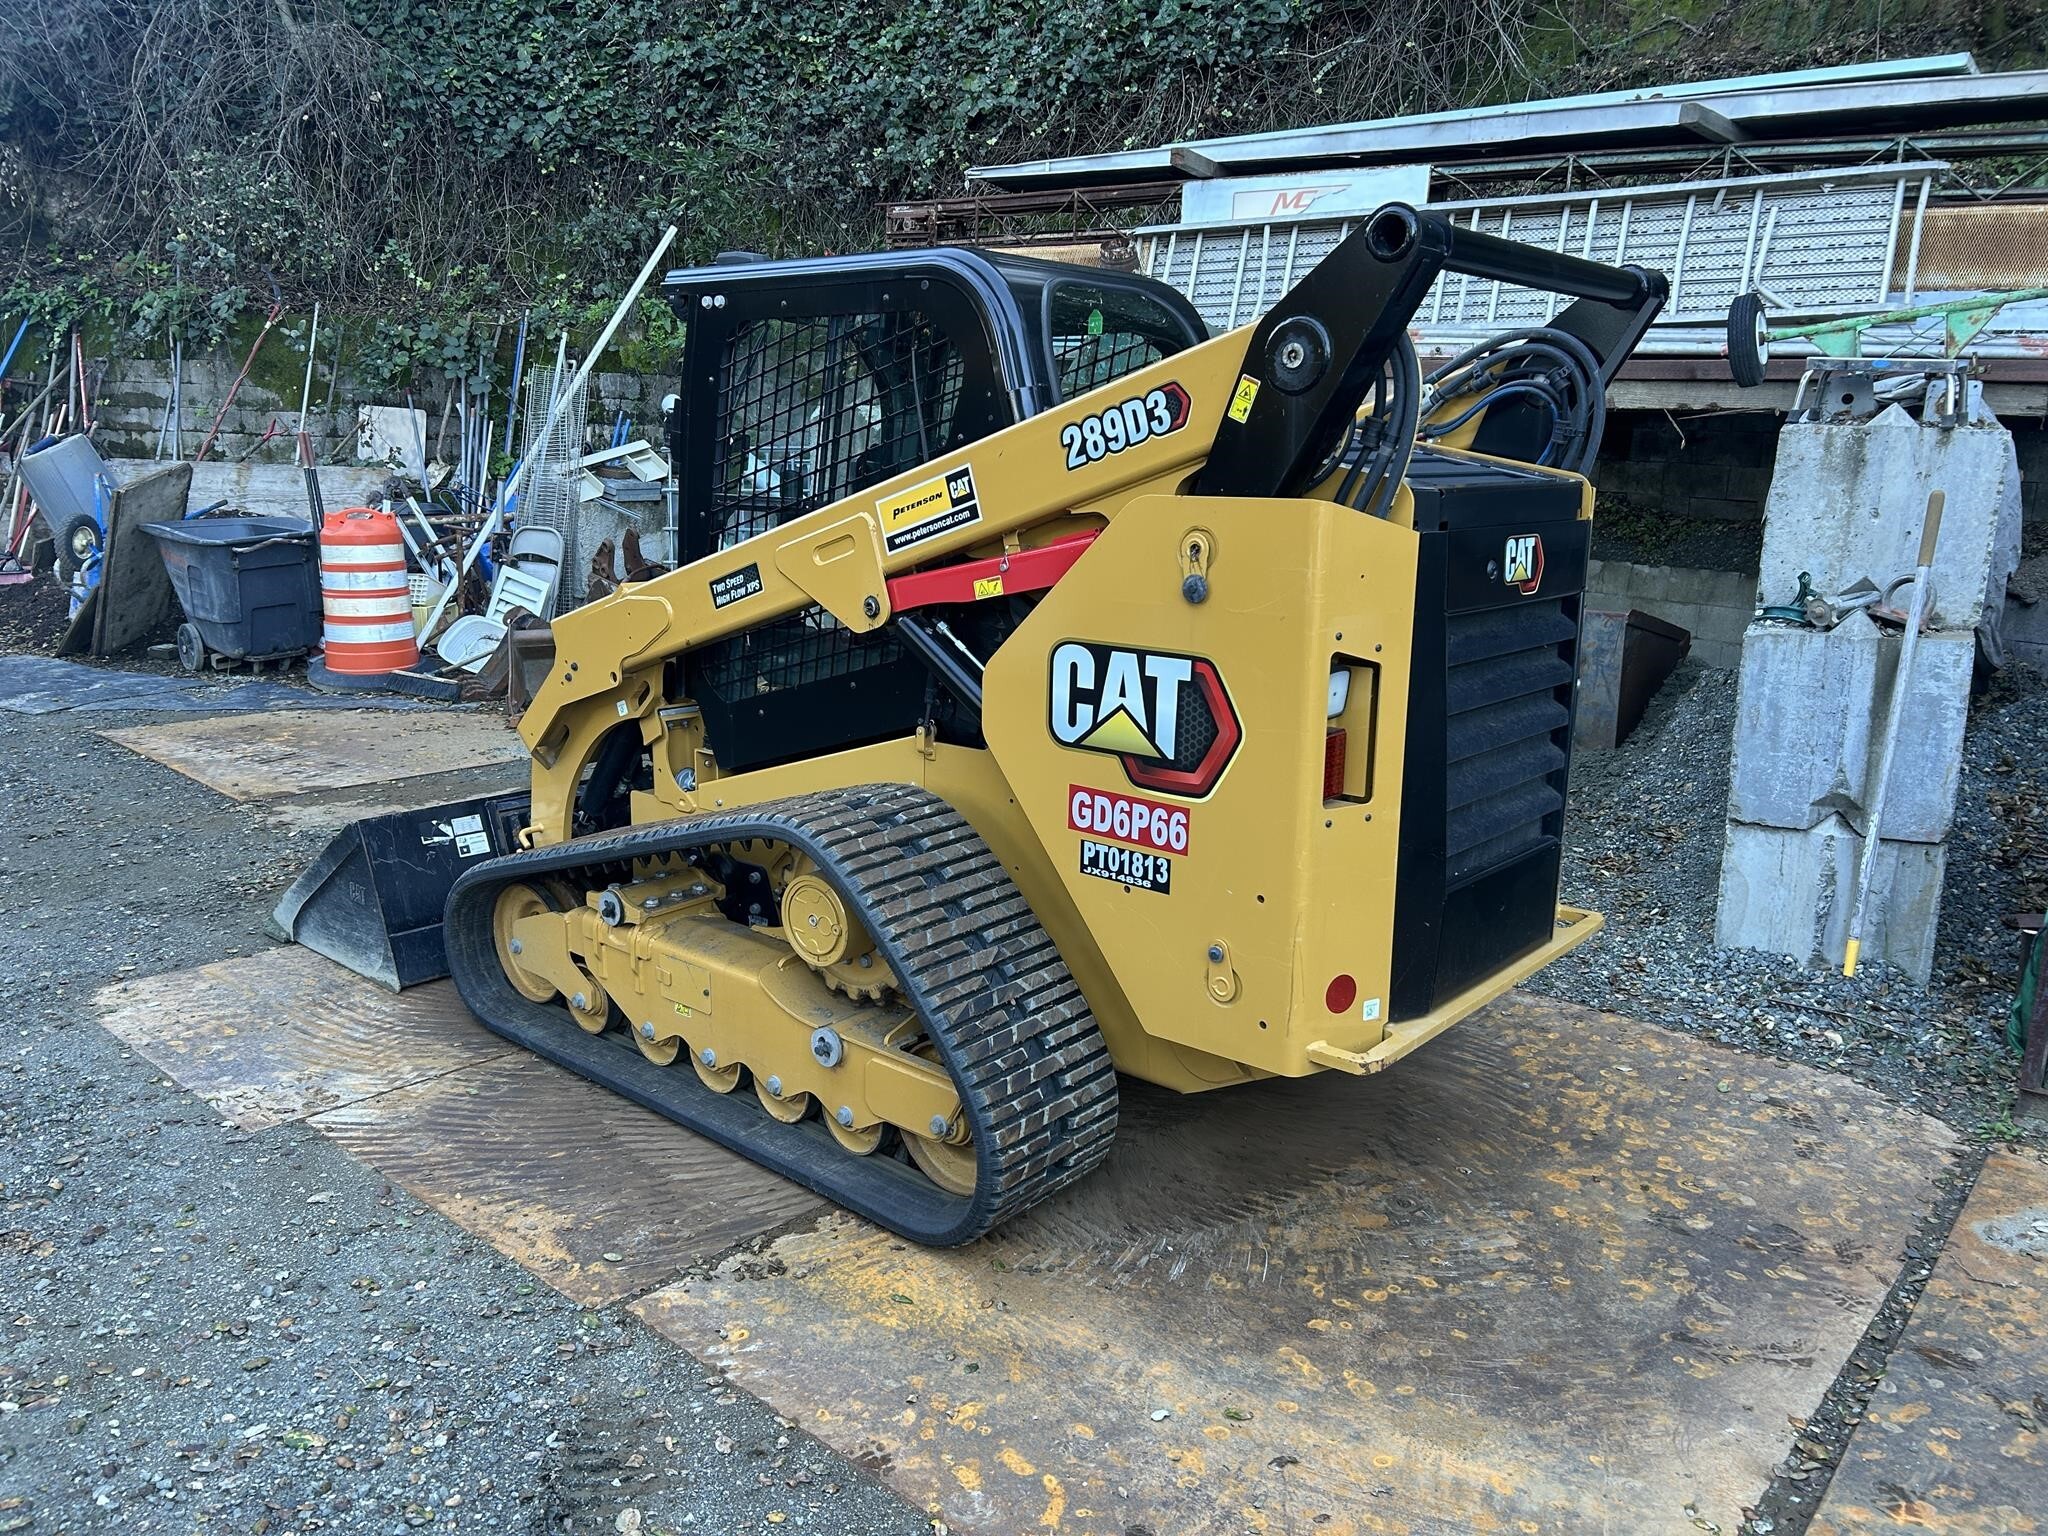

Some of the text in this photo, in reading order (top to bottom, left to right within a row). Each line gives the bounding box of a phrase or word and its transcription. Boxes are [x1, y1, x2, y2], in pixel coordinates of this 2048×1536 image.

[1063, 390, 1172, 469] 289D3
[892, 476, 970, 520] PETERSON CAT
[894, 510, 971, 545] www.petersoncat.com
[1505, 537, 1535, 581] CAT
[726, 574, 744, 588] SPEED
[746, 580, 760, 593] XPS
[1052, 644, 1192, 760] CAT
[1071, 791, 1188, 851] GD6P66
[1083, 841, 1169, 884] PT01813
[1083, 866, 1152, 888] JX914836
